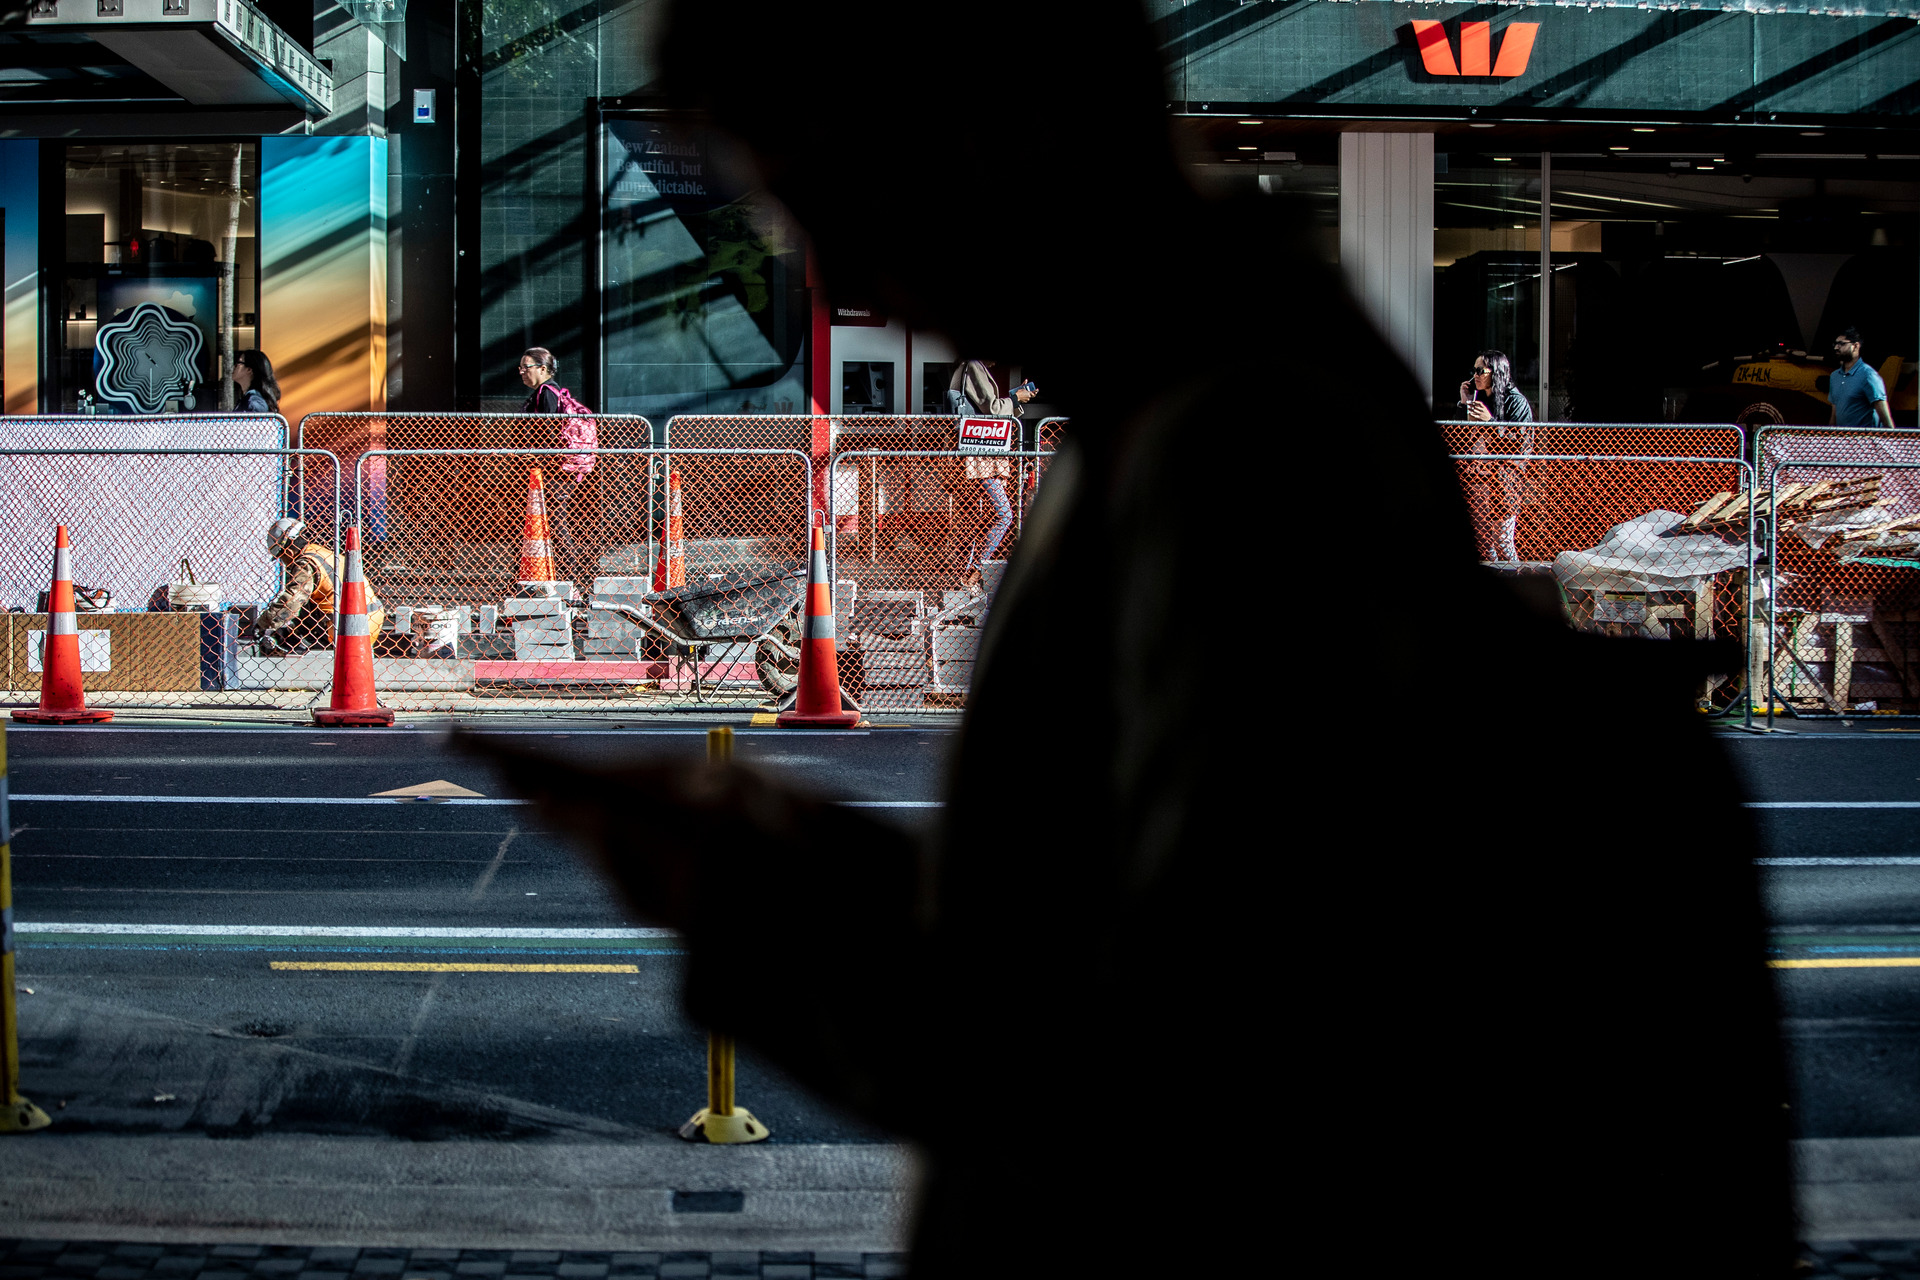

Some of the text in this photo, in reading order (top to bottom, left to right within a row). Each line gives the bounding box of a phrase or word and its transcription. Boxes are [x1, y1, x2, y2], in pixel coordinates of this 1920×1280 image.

[616, 140, 700, 157] New Zealand.
[617, 159, 702, 176] Beautiful, but
[616, 180, 706, 196] unpredictable.
[837, 308, 871, 317] Withdrawals
[1737, 367, 1771, 382] ZK-HLN
[965, 423, 1005, 439] rapid
